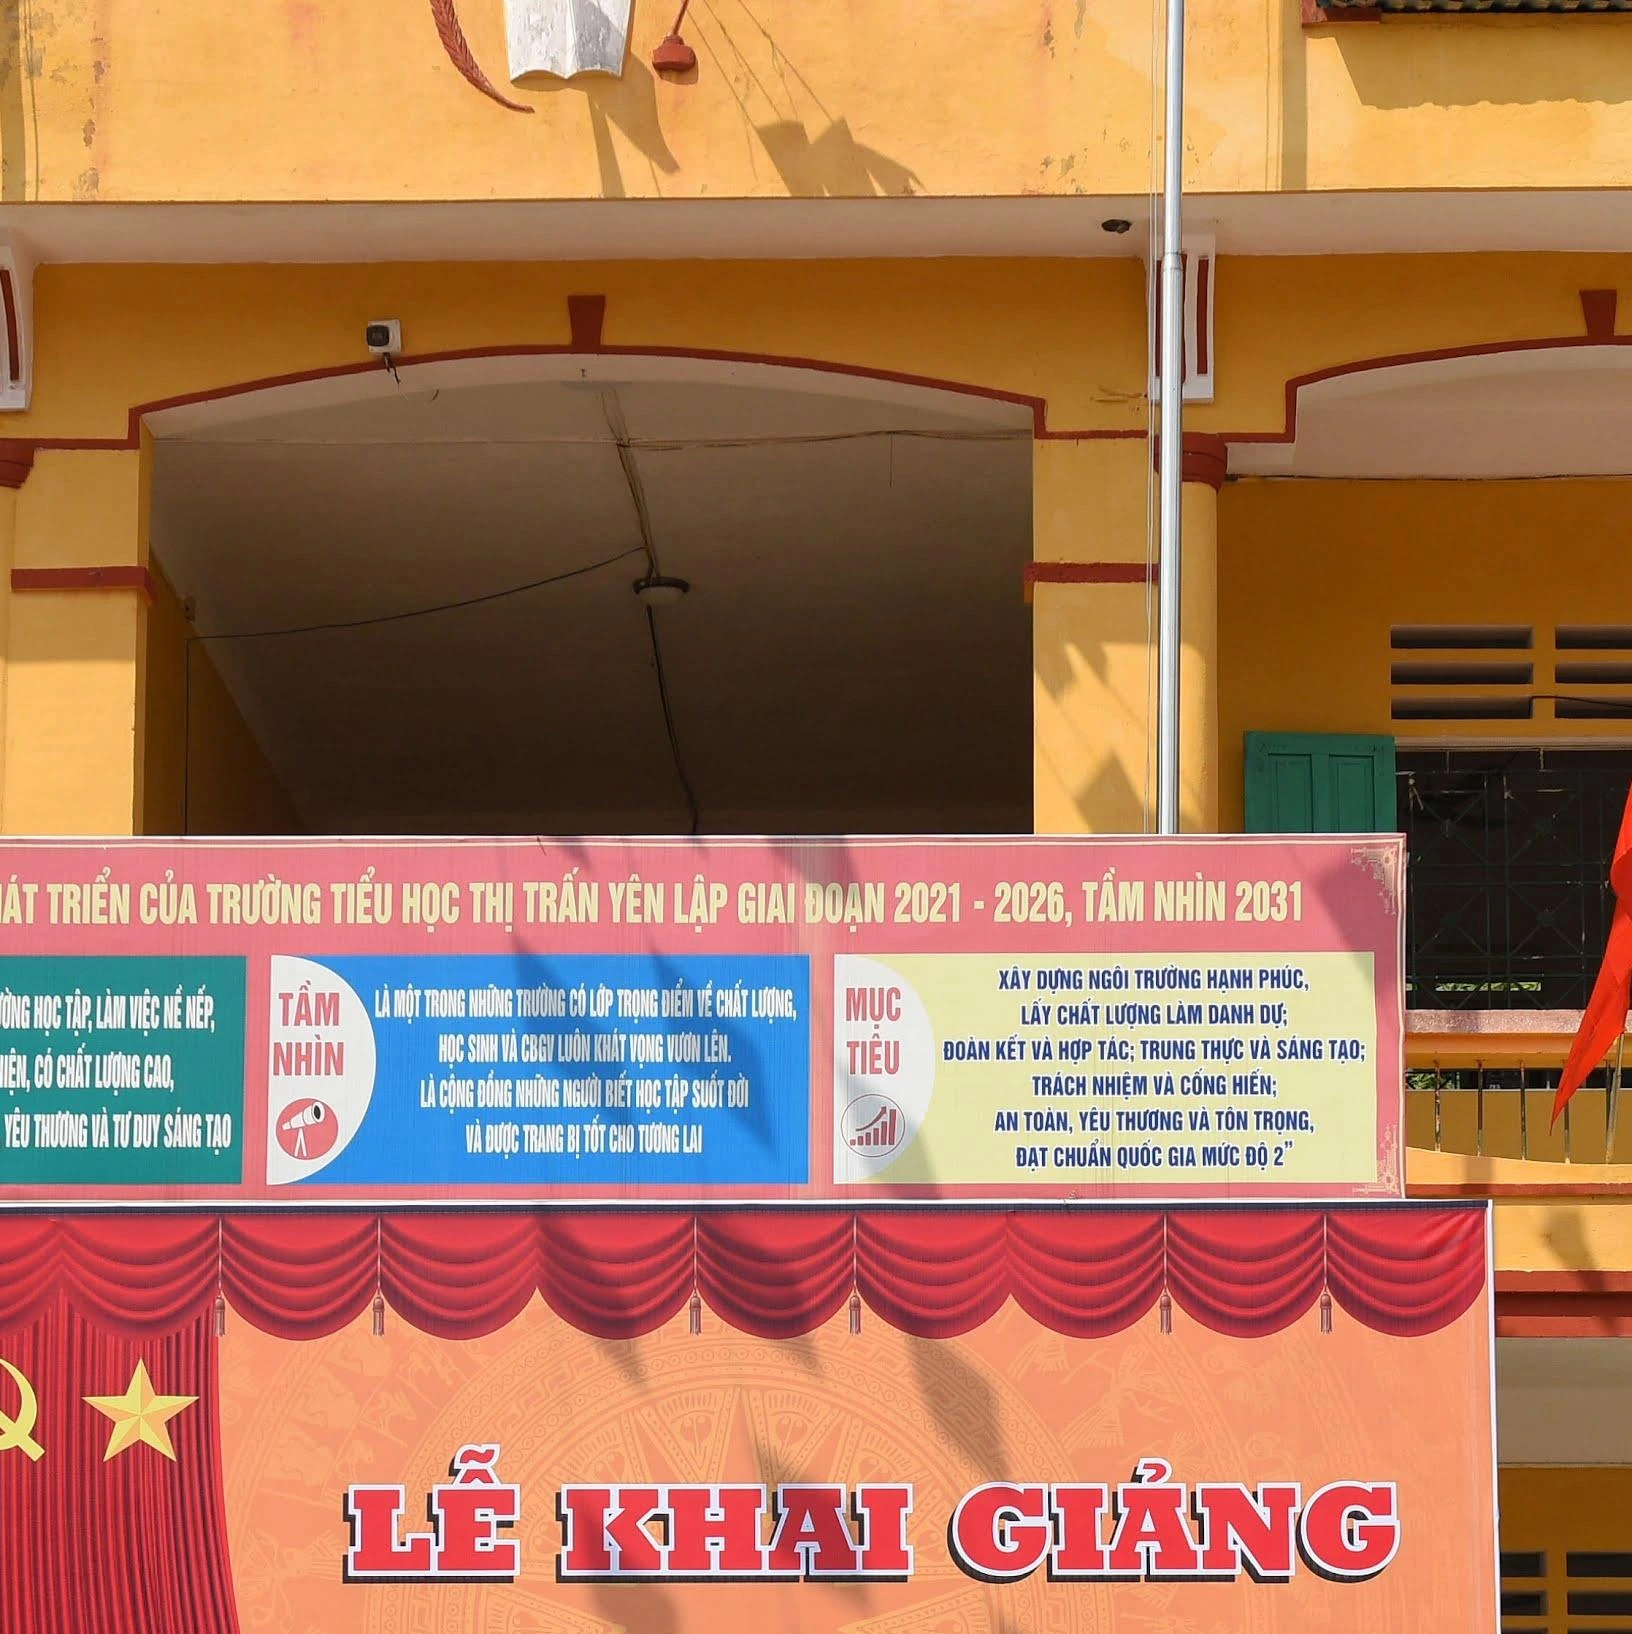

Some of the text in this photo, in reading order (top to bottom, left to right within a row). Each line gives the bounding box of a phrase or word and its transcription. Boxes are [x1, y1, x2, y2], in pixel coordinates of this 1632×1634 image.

[47, 866, 129, 924] TRIỂN
[140, 870, 197, 924] CỦA
[206, 873, 321, 925] TRƯỜNG
[330, 866, 392, 924] TIỂU
[402, 882, 459, 933] HỌC
[469, 882, 512, 932] THỊ
[523, 867, 598, 924] TRẤN
[608, 874, 664, 923] YÊN
[673, 874, 727, 933] LẬP
[737, 882, 794, 923] GIAI
[804, 882, 884, 933] ĐOẠN
[894, 881, 960, 923] 2021
[974, 900, 984, 910] -
[994, 881, 1073, 928] 2026,
[1082, 867, 1144, 922] TẦM
[1154, 872, 1225, 922] NHÌN
[1235, 880, 1302, 922] 2031
[375, 977, 797, 1024] LÀ MỘT TRONG NHỮNG TRƯỜNG CÓ LỚP TRỌNG ĐIỂM VỀ CHẤT LƯỢNG,
[998, 965, 1309, 995] XÂY DỰNG NGÔI TRƯỜNG HẠNH PHÚC,
[33, 995, 62, 1037] HỌC
[65, 988, 92, 1037] TẬP,
[96, 988, 126, 1030] LÀM
[129, 988, 161, 1037] VIỆC
[163, 983, 183, 1029] NỀ
[185, 983, 215, 1033] NẾP,
[278, 980, 340, 1027] TẦM
[845, 986, 901, 1029] MỤC
[273, 1034, 344, 1076] NHÌN
[846, 1032, 900, 1075] TIÊU
[943, 1034, 1365, 1065] ĐOÀN KẾT VÀ HỢP TÁC; TRUNG THỰC VÀ SÁNG TẠO;
[420, 1069, 749, 1114] LÀ CỘNG ĐỒNG NHỮNG NGƯỜI BIẾT HỌC TẬP SUỐT ĐỜI
[4, 1106, 30, 1148] YÊU
[33, 1109, 88, 1148] THƯƠNG
[91, 1106, 108, 1148] VÀ
[113, 1110, 132, 1148] TƯ
[133, 1113, 161, 1148] DUY
[163, 1107, 202, 1148] SÁNG
[205, 1113, 232, 1155] TẠO
[994, 1107, 1314, 1135] AN TOÀN, YÊU THƯƠNG VÀ TÔN TRỌNG,
[348, 1445, 1400, 1575] LỄ KHAI GIẢNG
